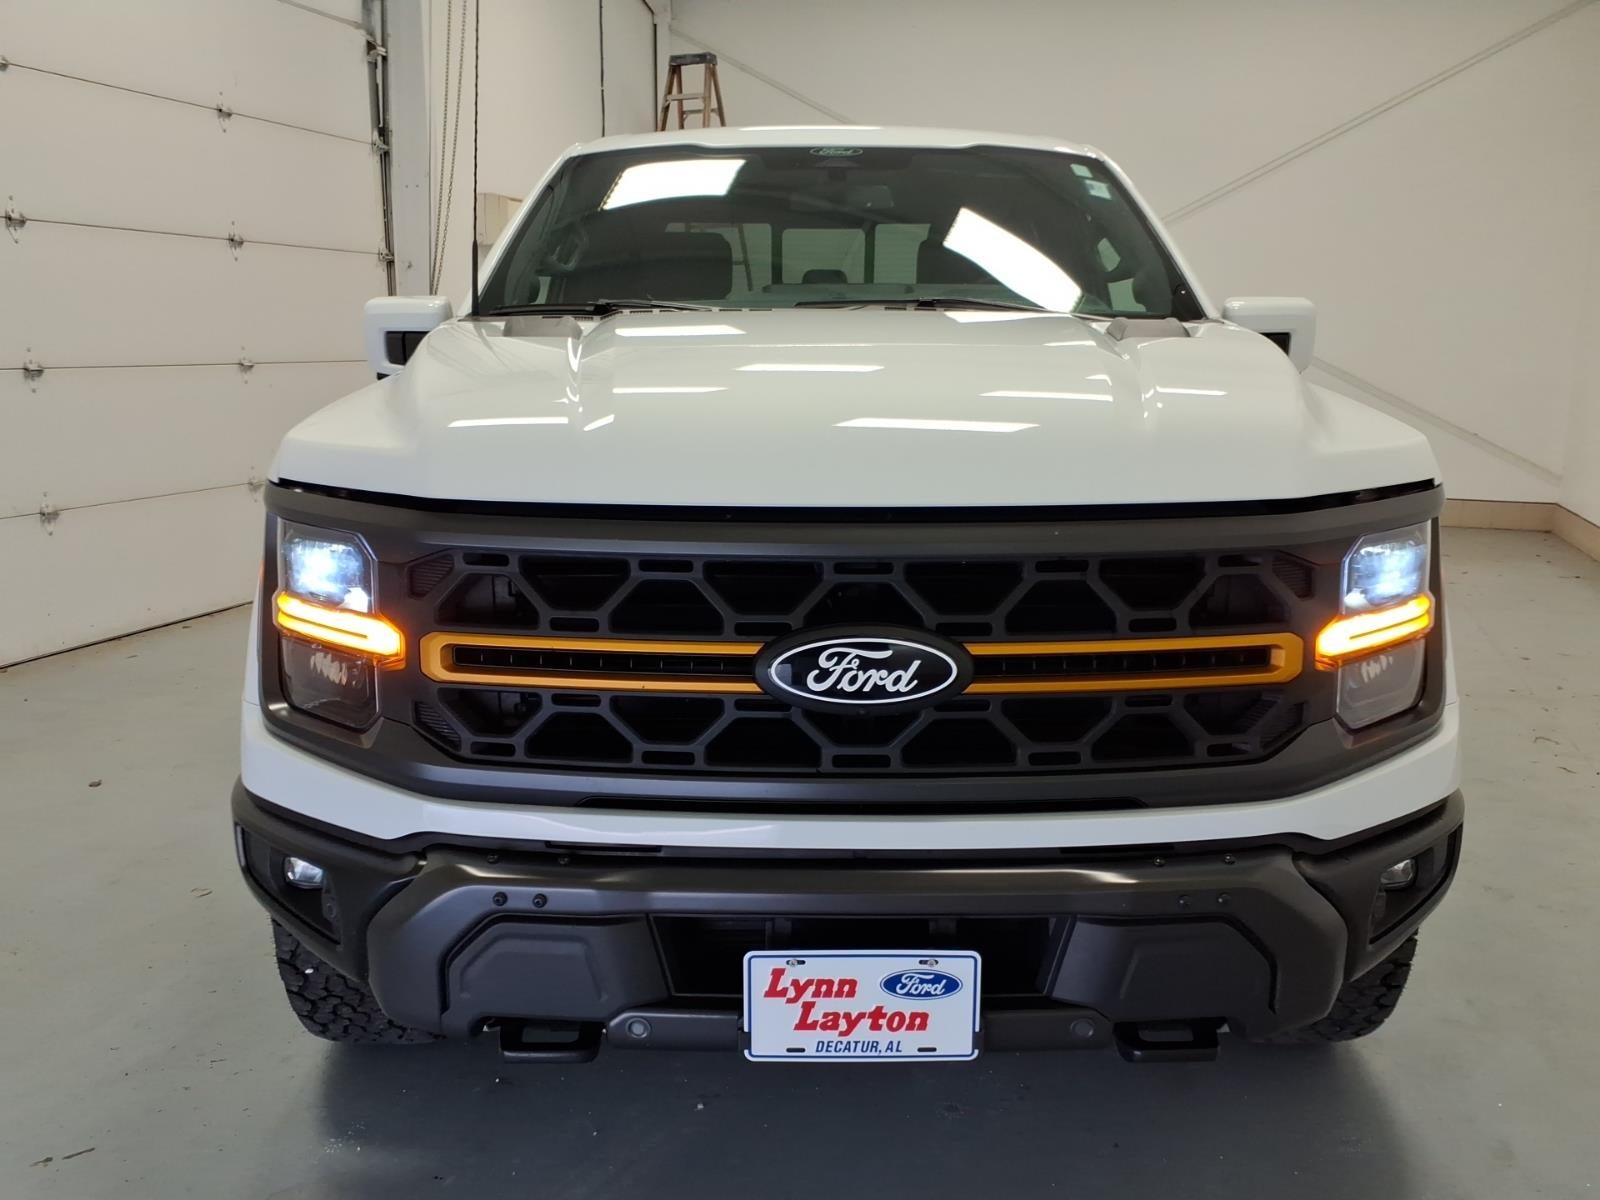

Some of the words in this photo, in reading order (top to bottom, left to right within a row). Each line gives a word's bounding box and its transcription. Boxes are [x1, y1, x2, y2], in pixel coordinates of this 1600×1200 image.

[806, 647, 922, 693] Ford
[763, 967, 858, 1004] Lynn
[895, 972, 947, 996] Ford
[793, 1001, 930, 1037] Layton
[815, 1040, 882, 1055] DECATUR,
[885, 1040, 903, 1053] AL
